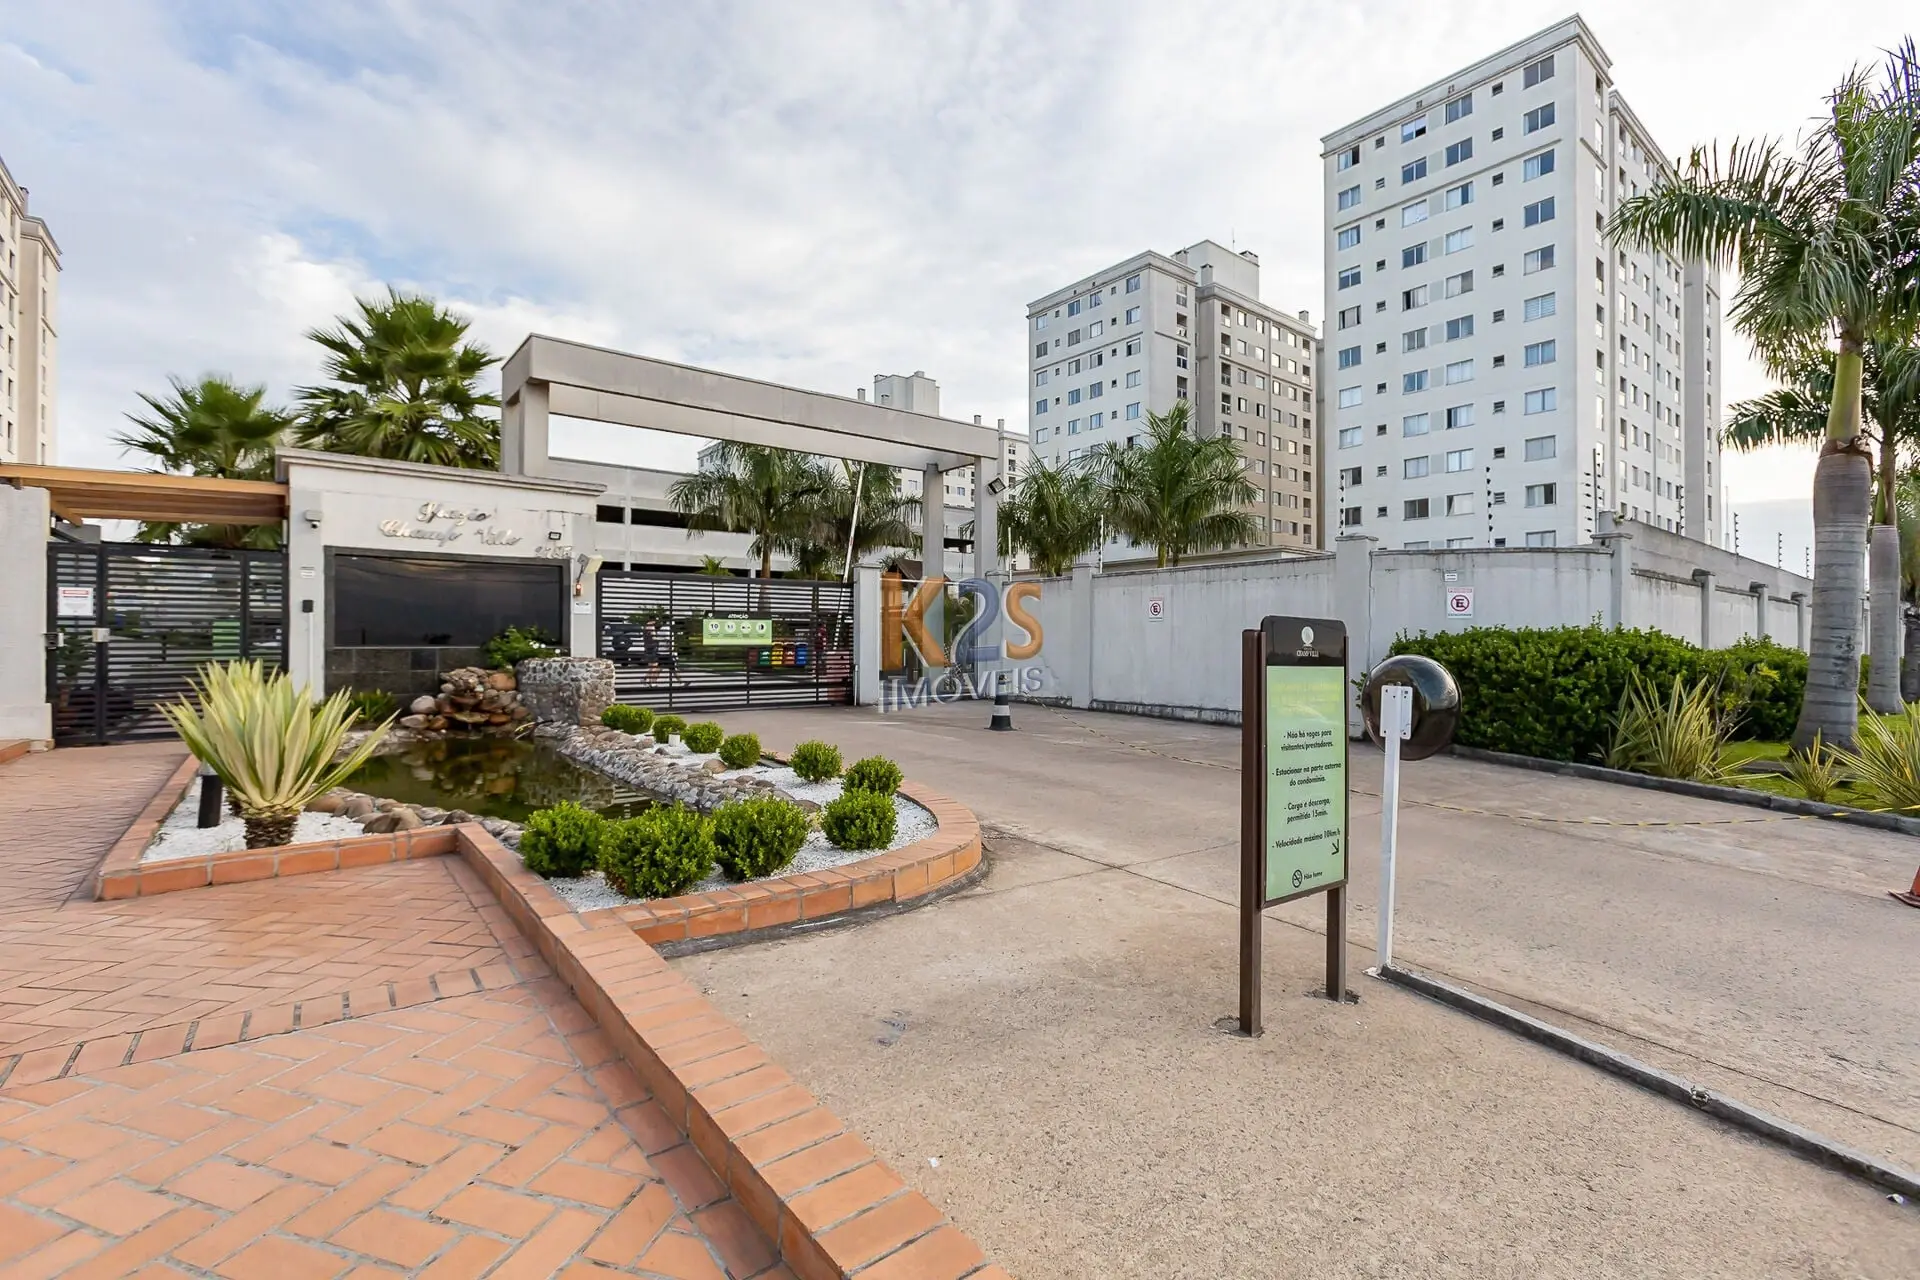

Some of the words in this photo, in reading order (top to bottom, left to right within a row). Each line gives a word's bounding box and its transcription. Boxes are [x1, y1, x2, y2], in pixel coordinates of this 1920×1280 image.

[1287, 731, 1298, 739] Não
[1276, 767, 1302, 776] Estacionar
[1288, 802, 1303, 811] Carga
[1276, 837, 1303, 848] Velocidade
